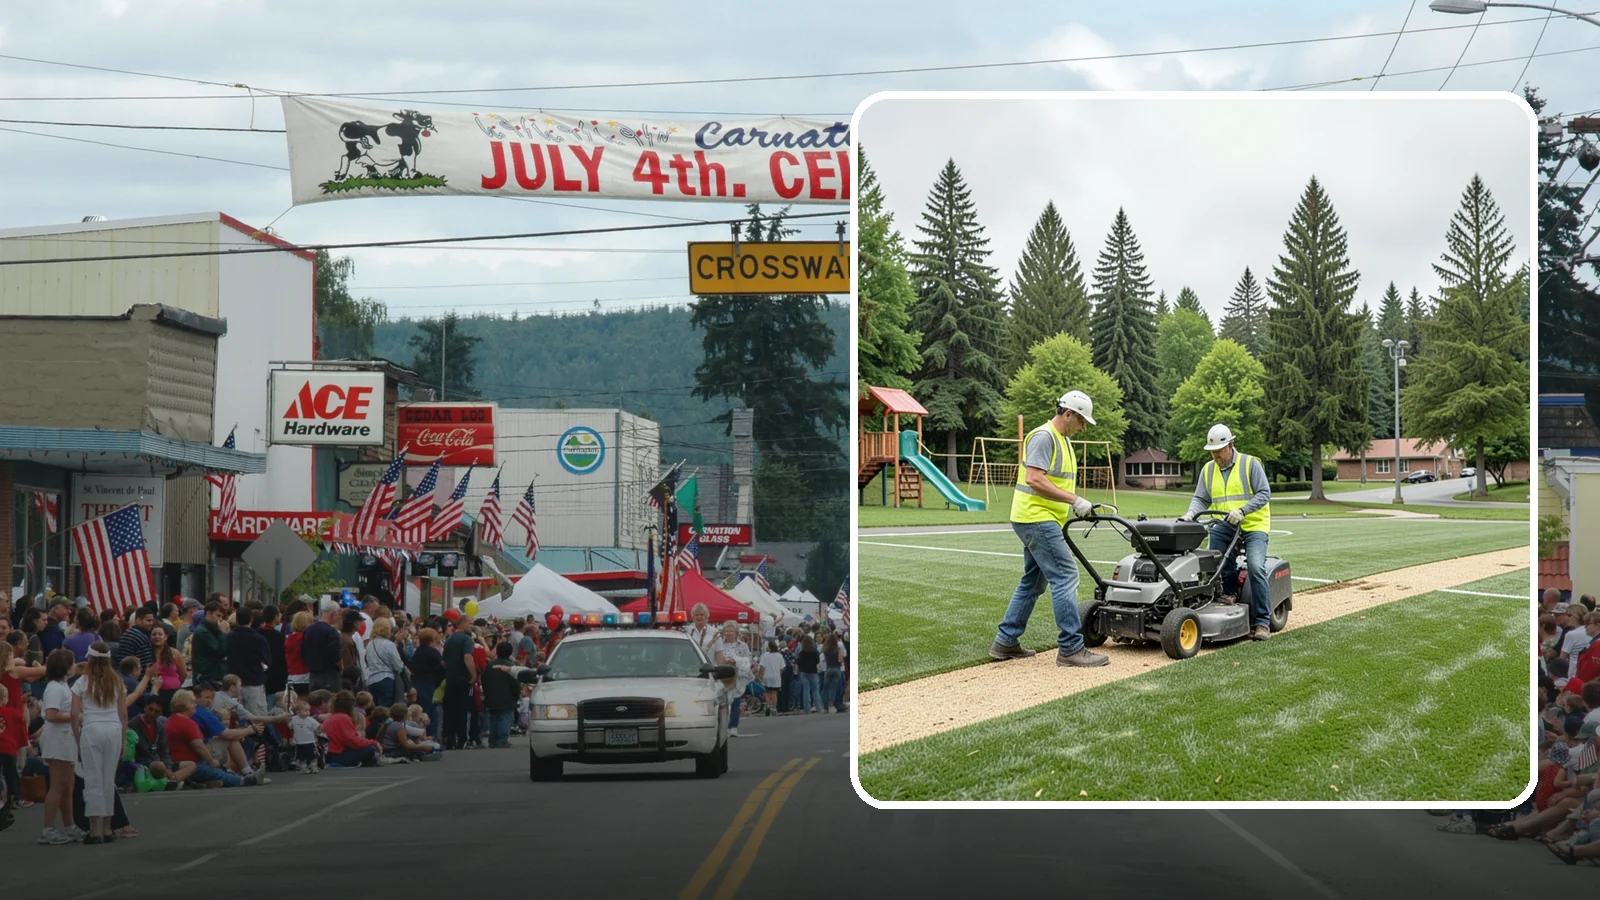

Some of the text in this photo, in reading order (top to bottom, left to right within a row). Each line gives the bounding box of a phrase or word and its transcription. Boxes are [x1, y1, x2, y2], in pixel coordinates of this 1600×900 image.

[481, 140, 605, 193] JULY
[632, 150, 746, 198] 4th.
[697, 255, 850, 280] CROSSWA
[282, 379, 374, 420] ACE
[405, 409, 452, 422] CEDAR
[283, 421, 371, 437] Hardware
[416, 428, 477, 447] Coca-Cola
[83, 484, 155, 495] St. Vincent de Paul
[213, 515, 331, 535] HARDARE
[688, 527, 741, 535] CRNATION
[699, 535, 730, 543] GLASS
